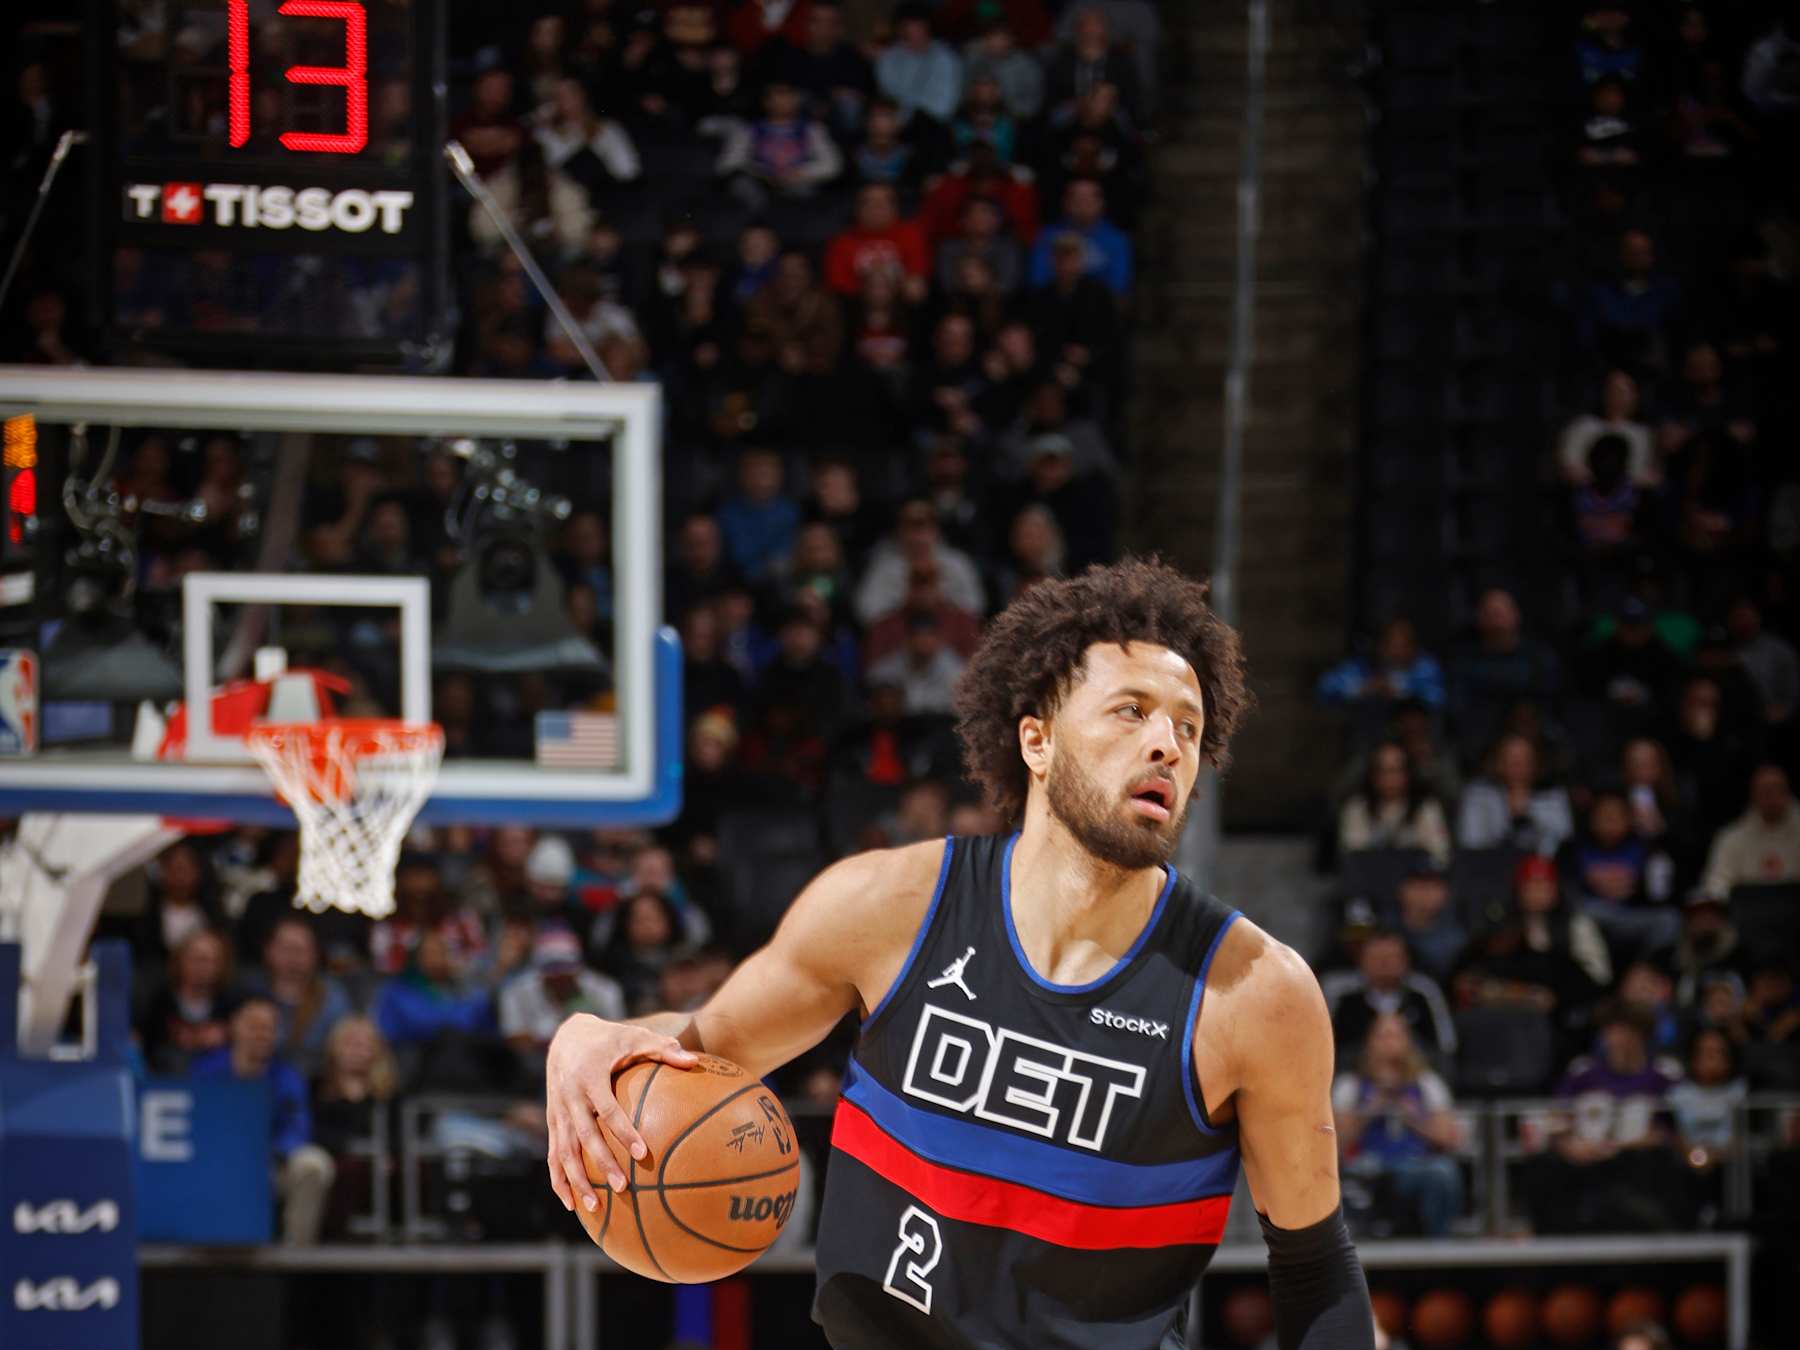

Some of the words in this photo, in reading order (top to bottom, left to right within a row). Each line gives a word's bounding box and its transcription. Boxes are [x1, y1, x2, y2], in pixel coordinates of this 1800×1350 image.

[228, 0, 367, 153] 13
[204, 183, 414, 234] TISSOT
[902, 1002, 1147, 1151] DET
[1089, 1007, 1169, 1040] StockX
[883, 1205, 943, 1315] 2
